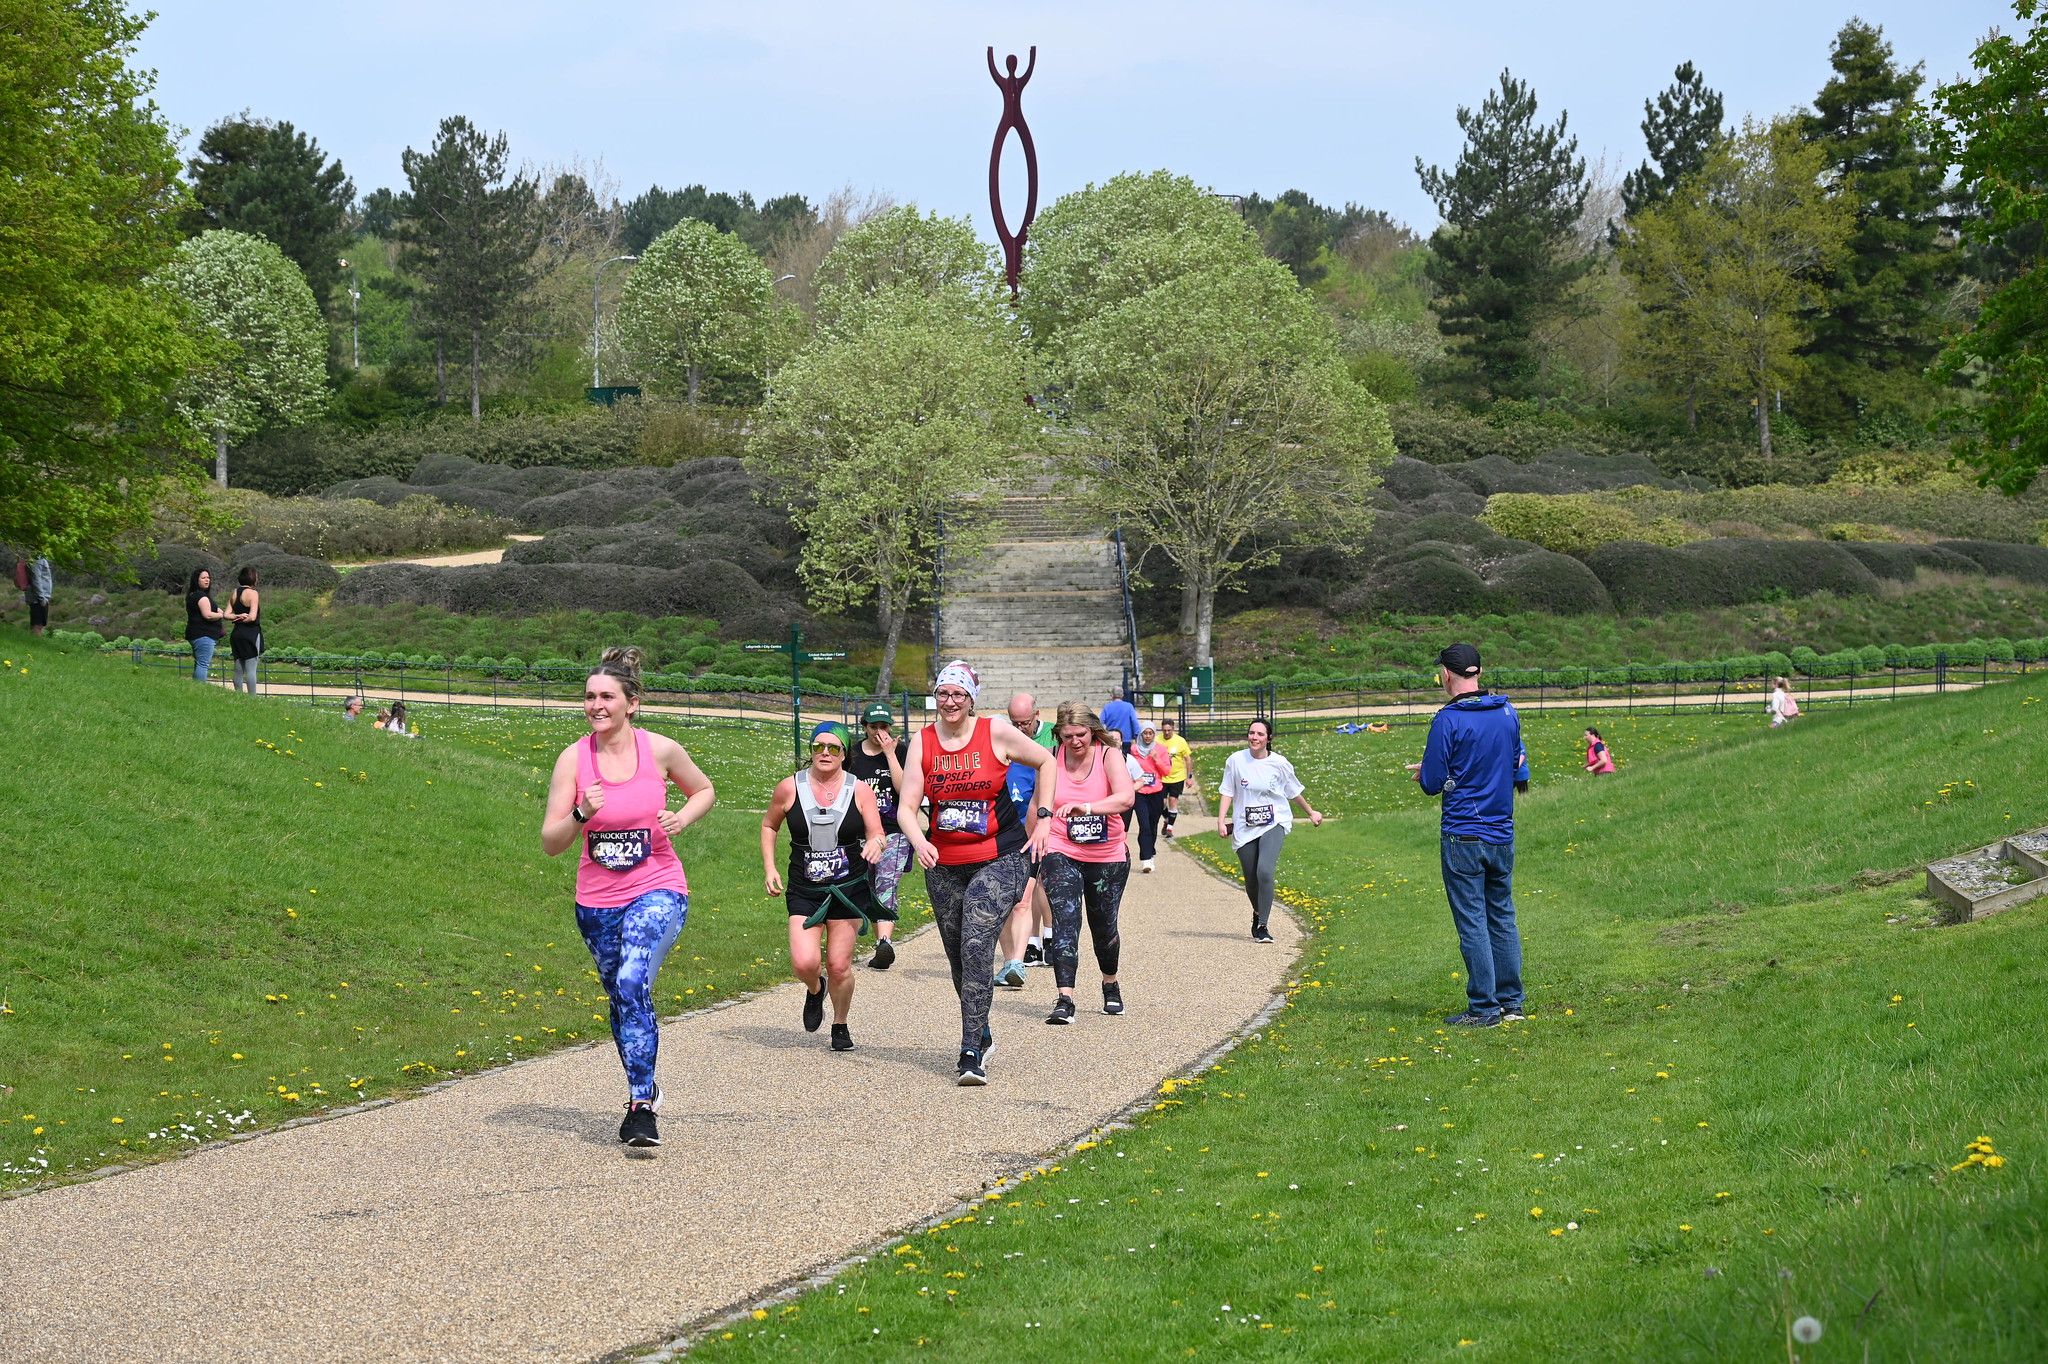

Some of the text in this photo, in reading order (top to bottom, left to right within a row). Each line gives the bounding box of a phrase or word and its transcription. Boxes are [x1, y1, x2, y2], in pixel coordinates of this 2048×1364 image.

[933, 751, 982, 773] JULIE
[926, 770, 976, 785] STOPSLEY
[943, 780, 993, 794] STRIDERS
[876, 798, 887, 807] 81
[947, 800, 971, 808] ROCKET
[972, 801, 981, 809] 5K
[1071, 822, 1103, 835] 10569
[600, 832, 628, 840] ROCKET
[629, 831, 641, 840] 5K
[597, 841, 643, 858] 10224
